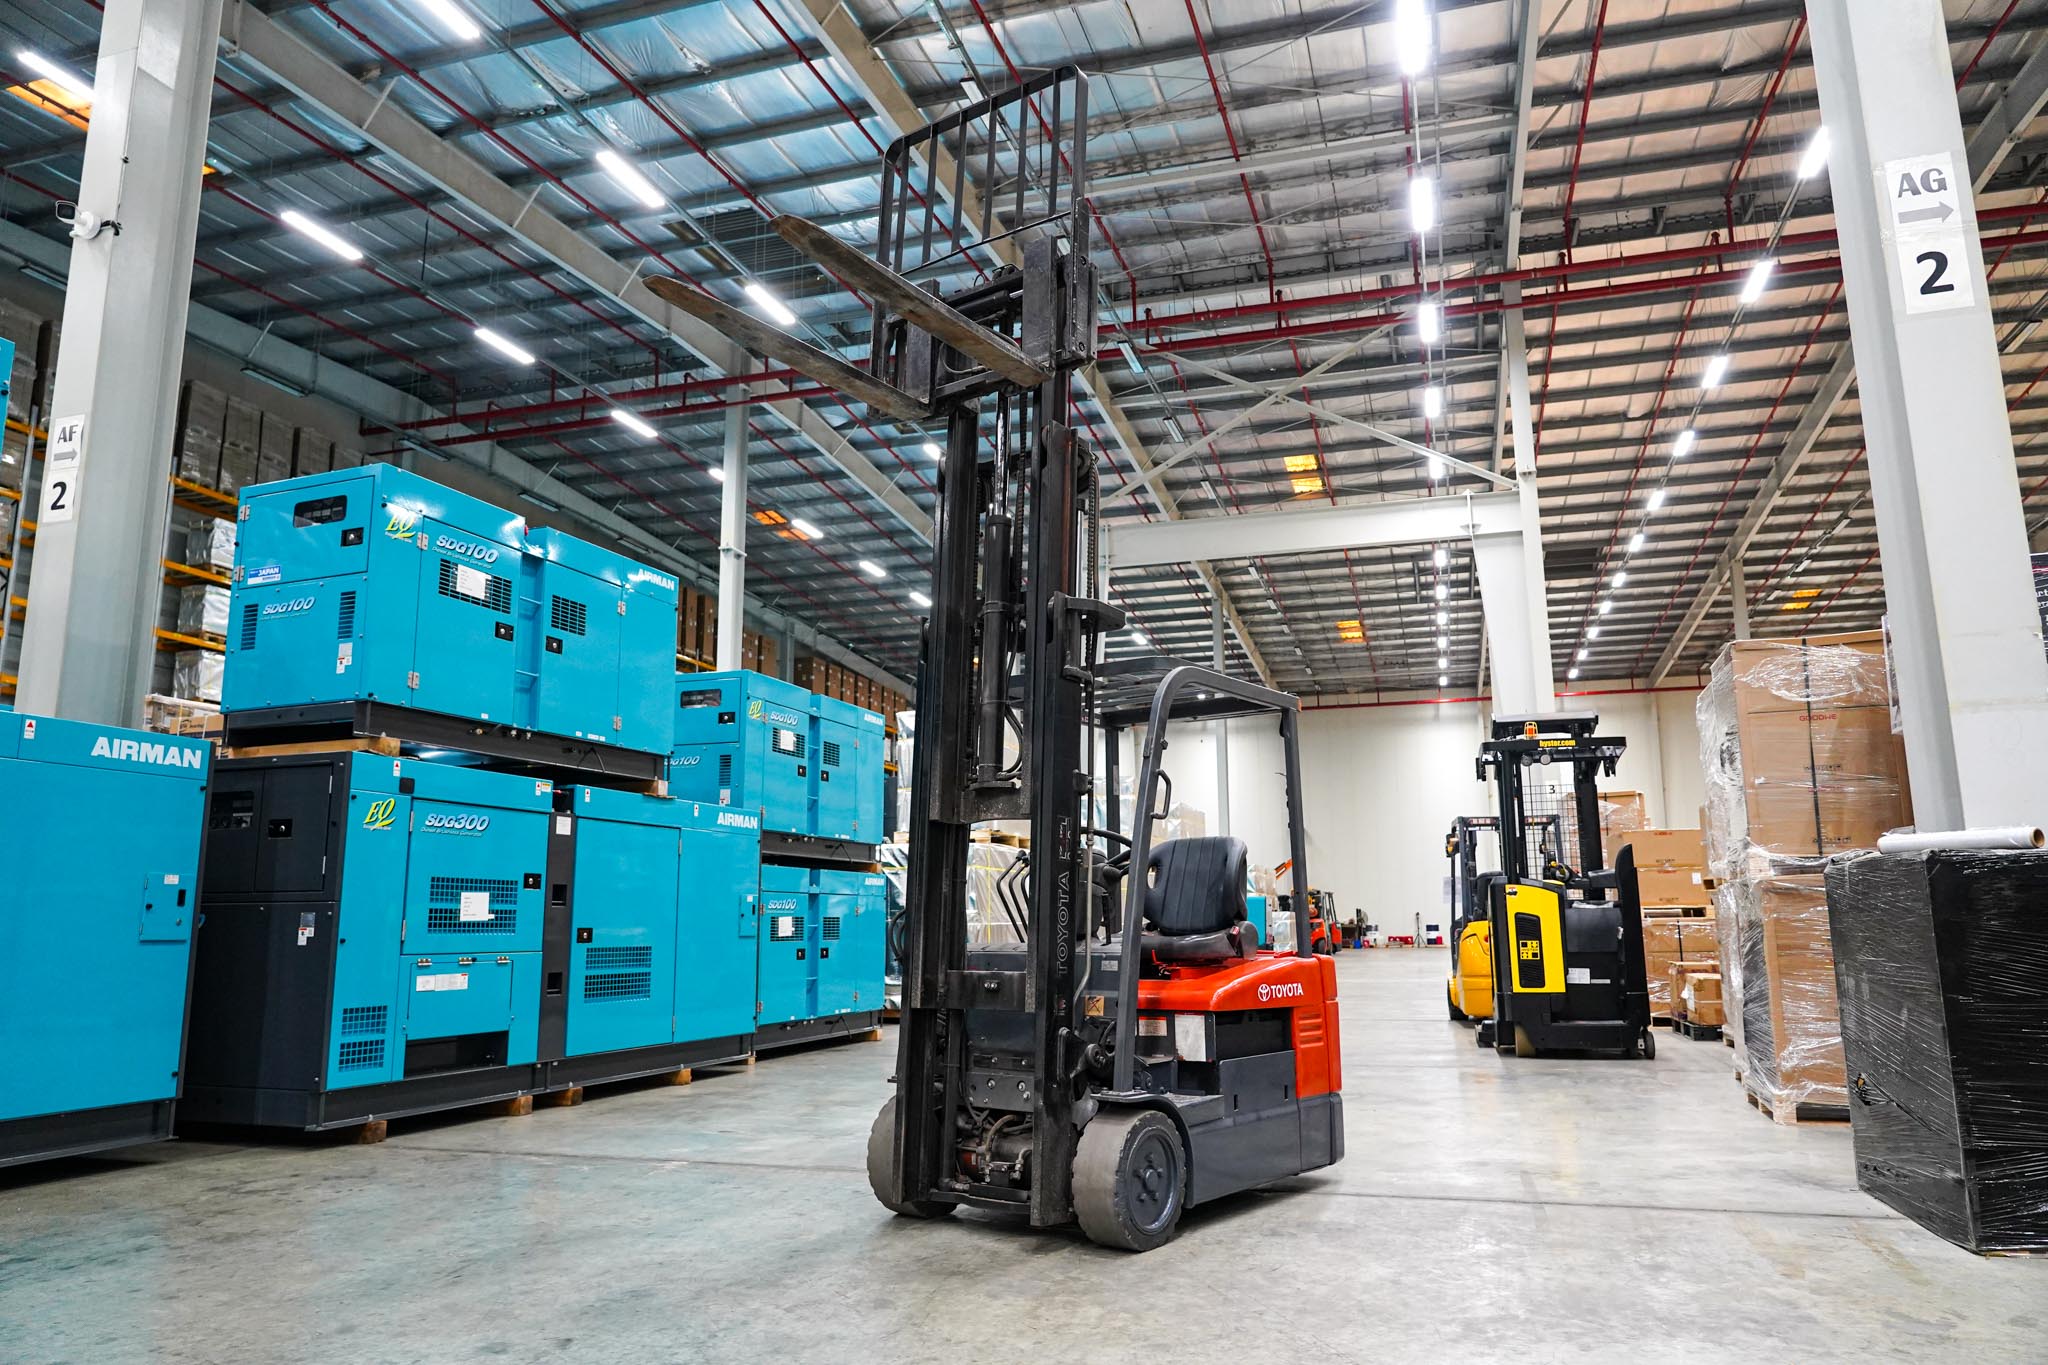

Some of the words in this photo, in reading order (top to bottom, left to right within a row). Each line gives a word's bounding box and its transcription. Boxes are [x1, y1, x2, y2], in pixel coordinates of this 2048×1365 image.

[1897, 168, 1948, 198] AG
[1916, 250, 1955, 295] 2
[57, 424, 79, 444] AF
[50, 481, 67, 511] 2
[385, 509, 416, 540] EQ
[436, 535, 498, 563] SDG100
[258, 566, 280, 577] JAPAN
[637, 568, 675, 591] AIRMAN
[263, 596, 316, 615] SDG100
[770, 711, 799, 726] SDG100
[91, 736, 202, 769] AIRMAN
[664, 755, 701, 766] G100
[1549, 784, 1556, 794] 3
[363, 797, 396, 830] EQ
[425, 813, 490, 832] SDG300
[717, 811, 758, 830] AIRMAN
[768, 898, 797, 910] SDG100
[1056, 871, 1070, 977] TOYOTA
[1271, 982, 1304, 999] TOYOTA
